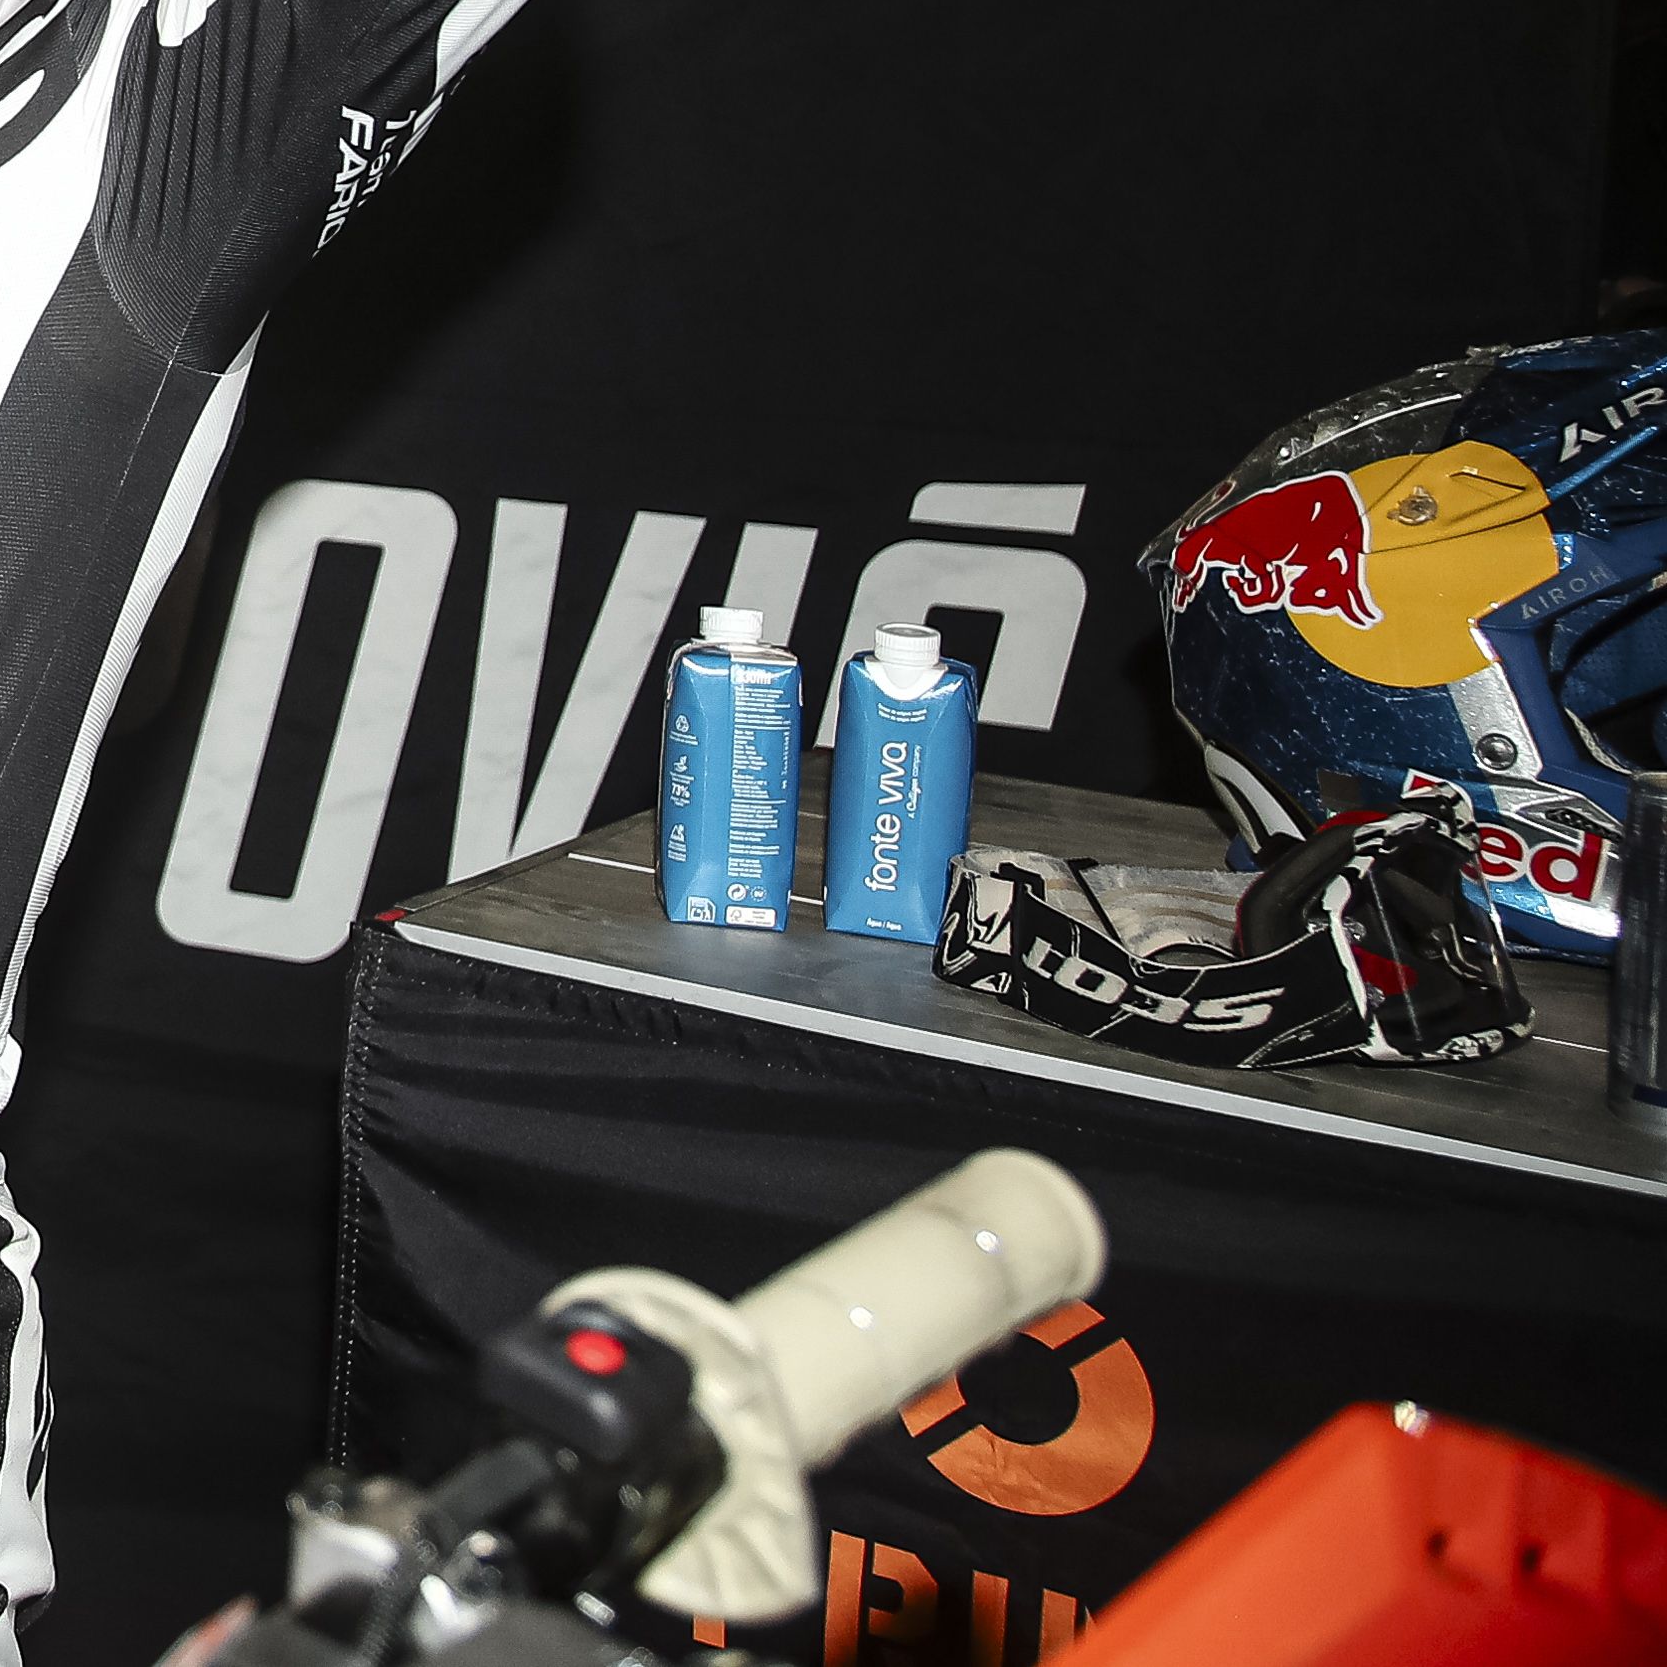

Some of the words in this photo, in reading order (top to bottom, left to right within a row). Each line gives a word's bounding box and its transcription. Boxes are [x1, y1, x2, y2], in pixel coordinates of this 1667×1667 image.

[311, 104, 376, 260] FARIO
[1520, 565, 1612, 621] AIROH
[877, 740, 909, 806] viva
[864, 813, 902, 892] fonte
